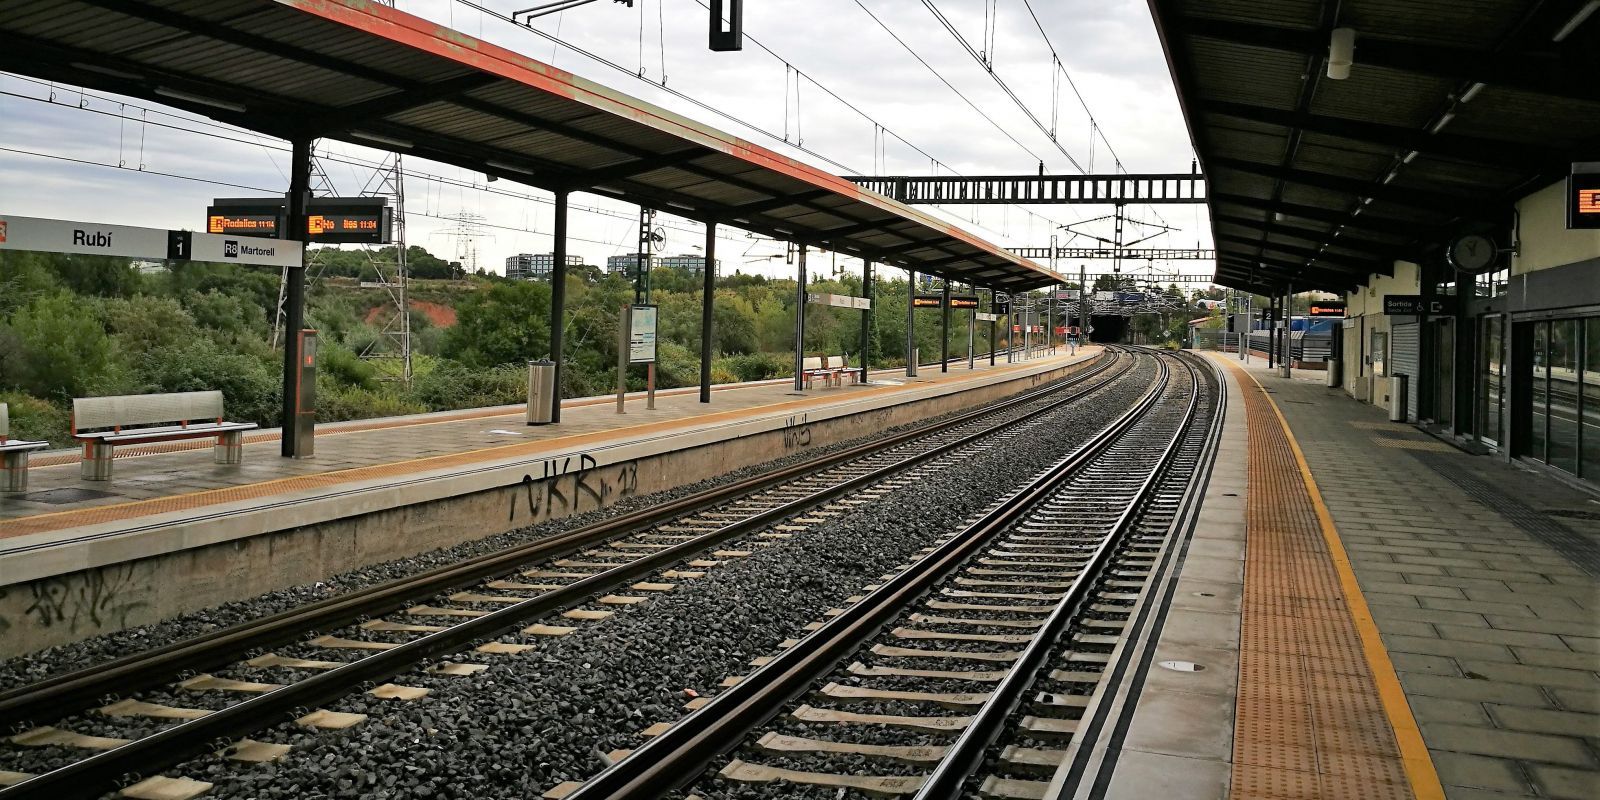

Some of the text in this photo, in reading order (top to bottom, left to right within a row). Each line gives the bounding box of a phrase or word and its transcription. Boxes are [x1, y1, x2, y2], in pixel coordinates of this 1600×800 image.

[73, 230, 112, 248] Rubí
[177, 241, 183, 256] 1
[225, 243, 274, 257] R8 Martorell
[1265, 312, 1272, 320] 2
